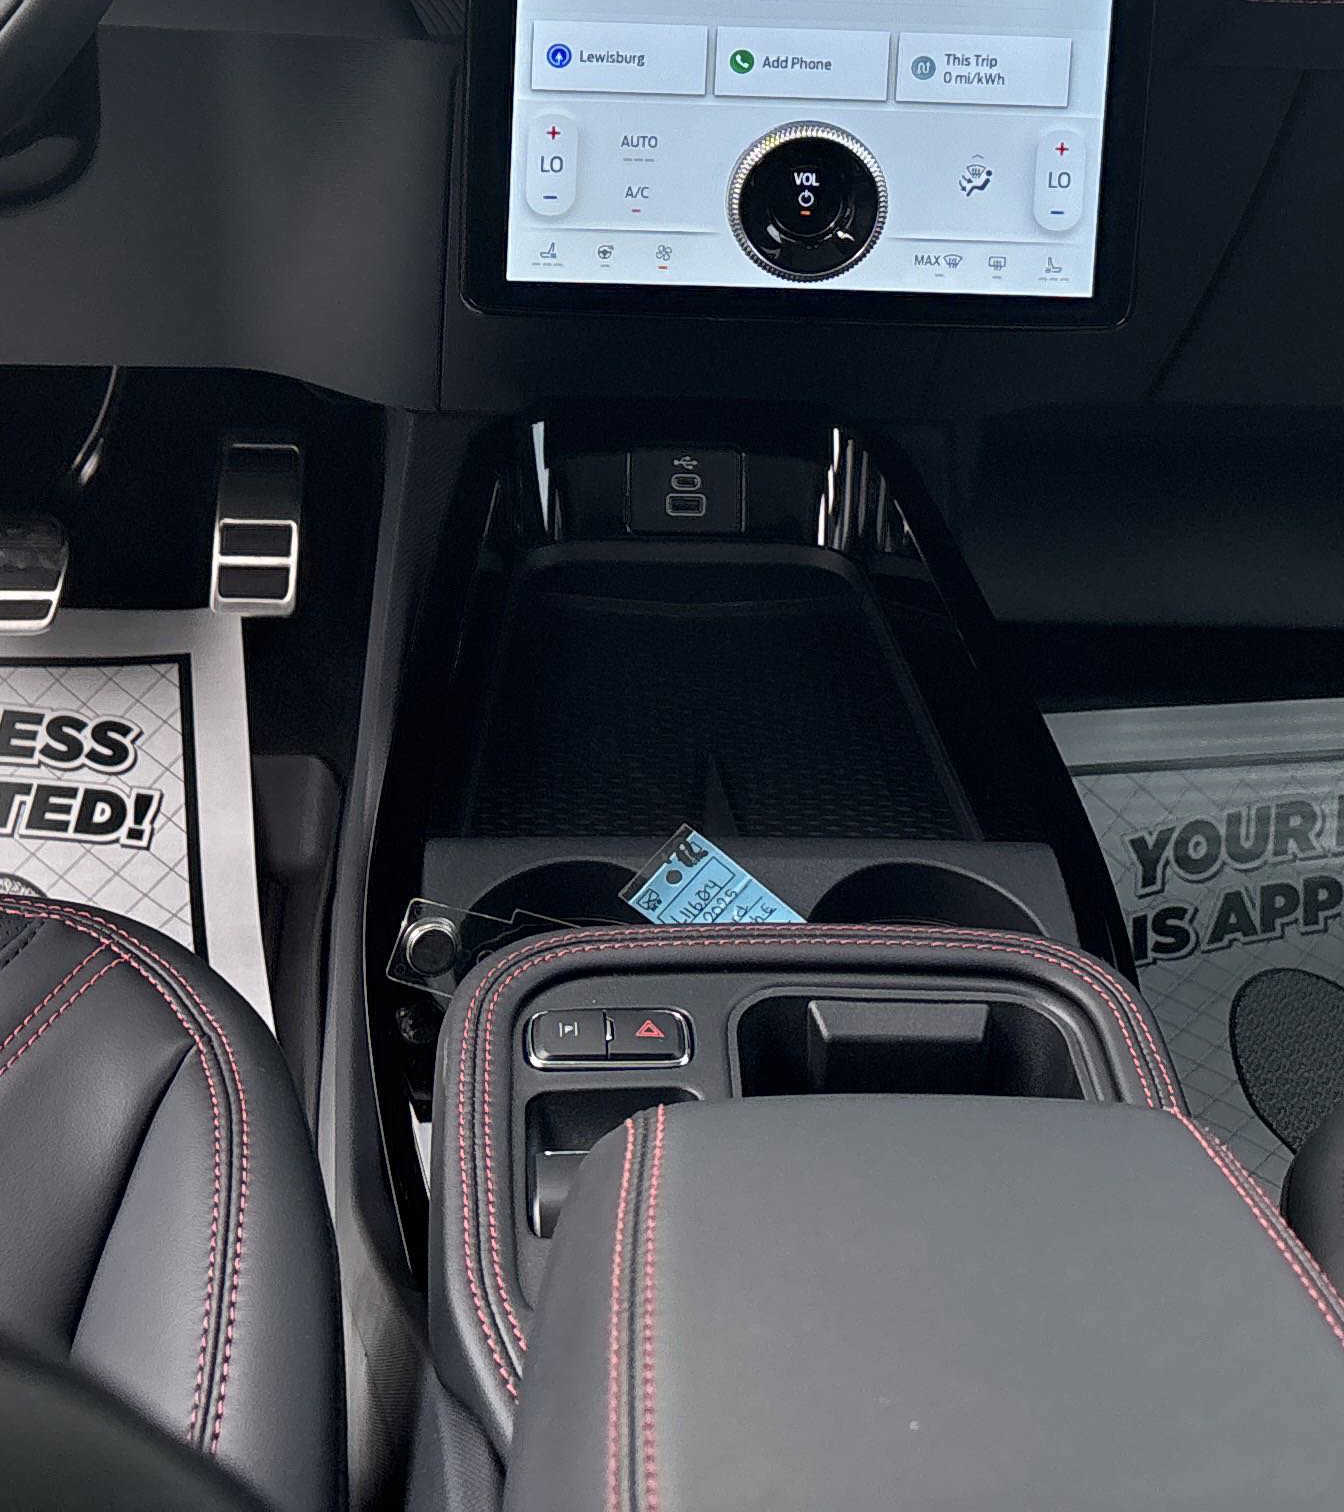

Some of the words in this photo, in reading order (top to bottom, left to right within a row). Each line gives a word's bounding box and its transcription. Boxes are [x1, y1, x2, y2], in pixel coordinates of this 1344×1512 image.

[579, 50, 645, 67] Lewisburg
[762, 56, 789, 69] Add
[790, 57, 832, 70] Phone
[944, 53, 972, 67] This
[974, 54, 998, 69] Trip
[943, 72, 953, 84] 0
[954, 72, 1005, 86] mi/kWh
[621, 135, 658, 149] AUTO
[540, 156, 564, 173] LO
[794, 172, 819, 187] VOL
[1048, 172, 1072, 189] LO
[625, 187, 650, 200] A/C
[914, 254, 941, 267] MAX
[1129, 798, 1326, 892] YOUR
[702, 889, 737, 923] 2025
[1132, 900, 1199, 964] IS
